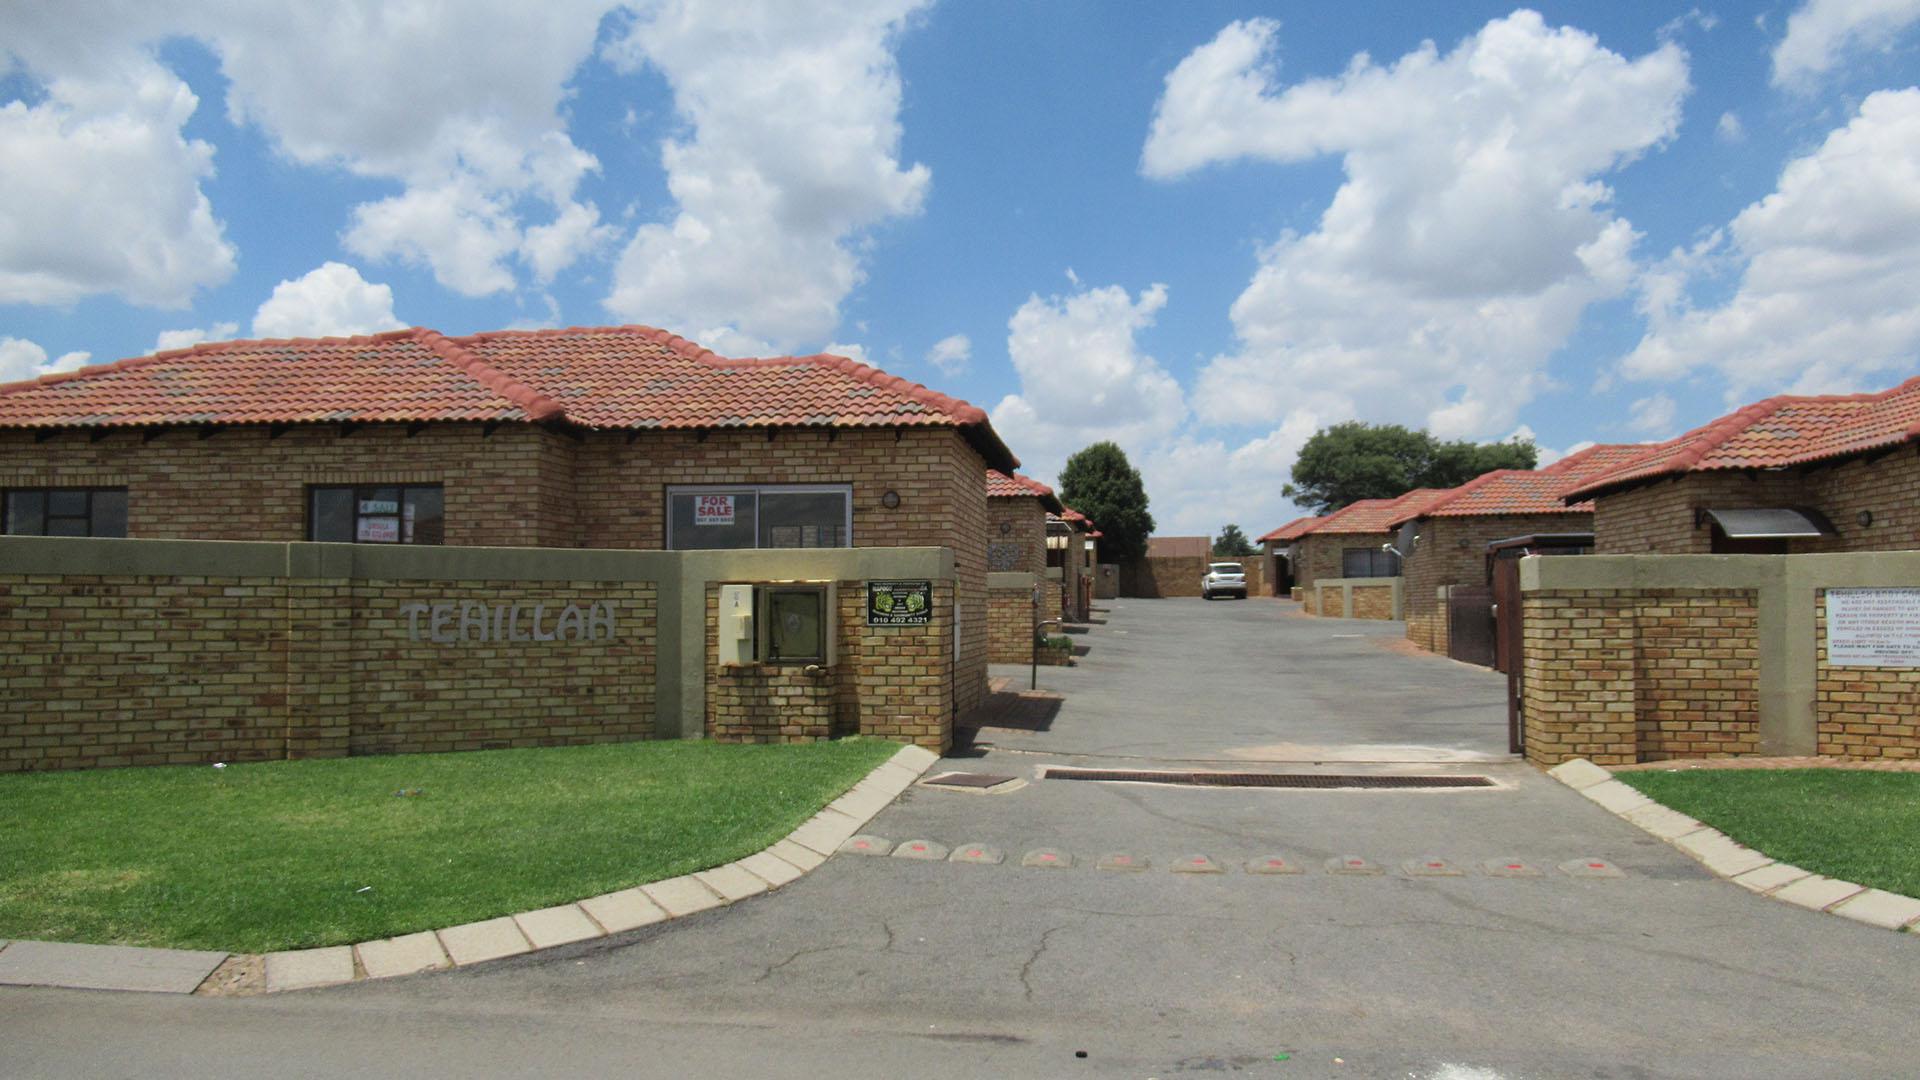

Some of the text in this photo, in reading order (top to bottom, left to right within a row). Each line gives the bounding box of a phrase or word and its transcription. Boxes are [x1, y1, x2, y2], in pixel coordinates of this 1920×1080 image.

[702, 496, 728, 506] FOR
[698, 506, 733, 516] SALE
[399, 599, 617, 643] TEHILLAH
